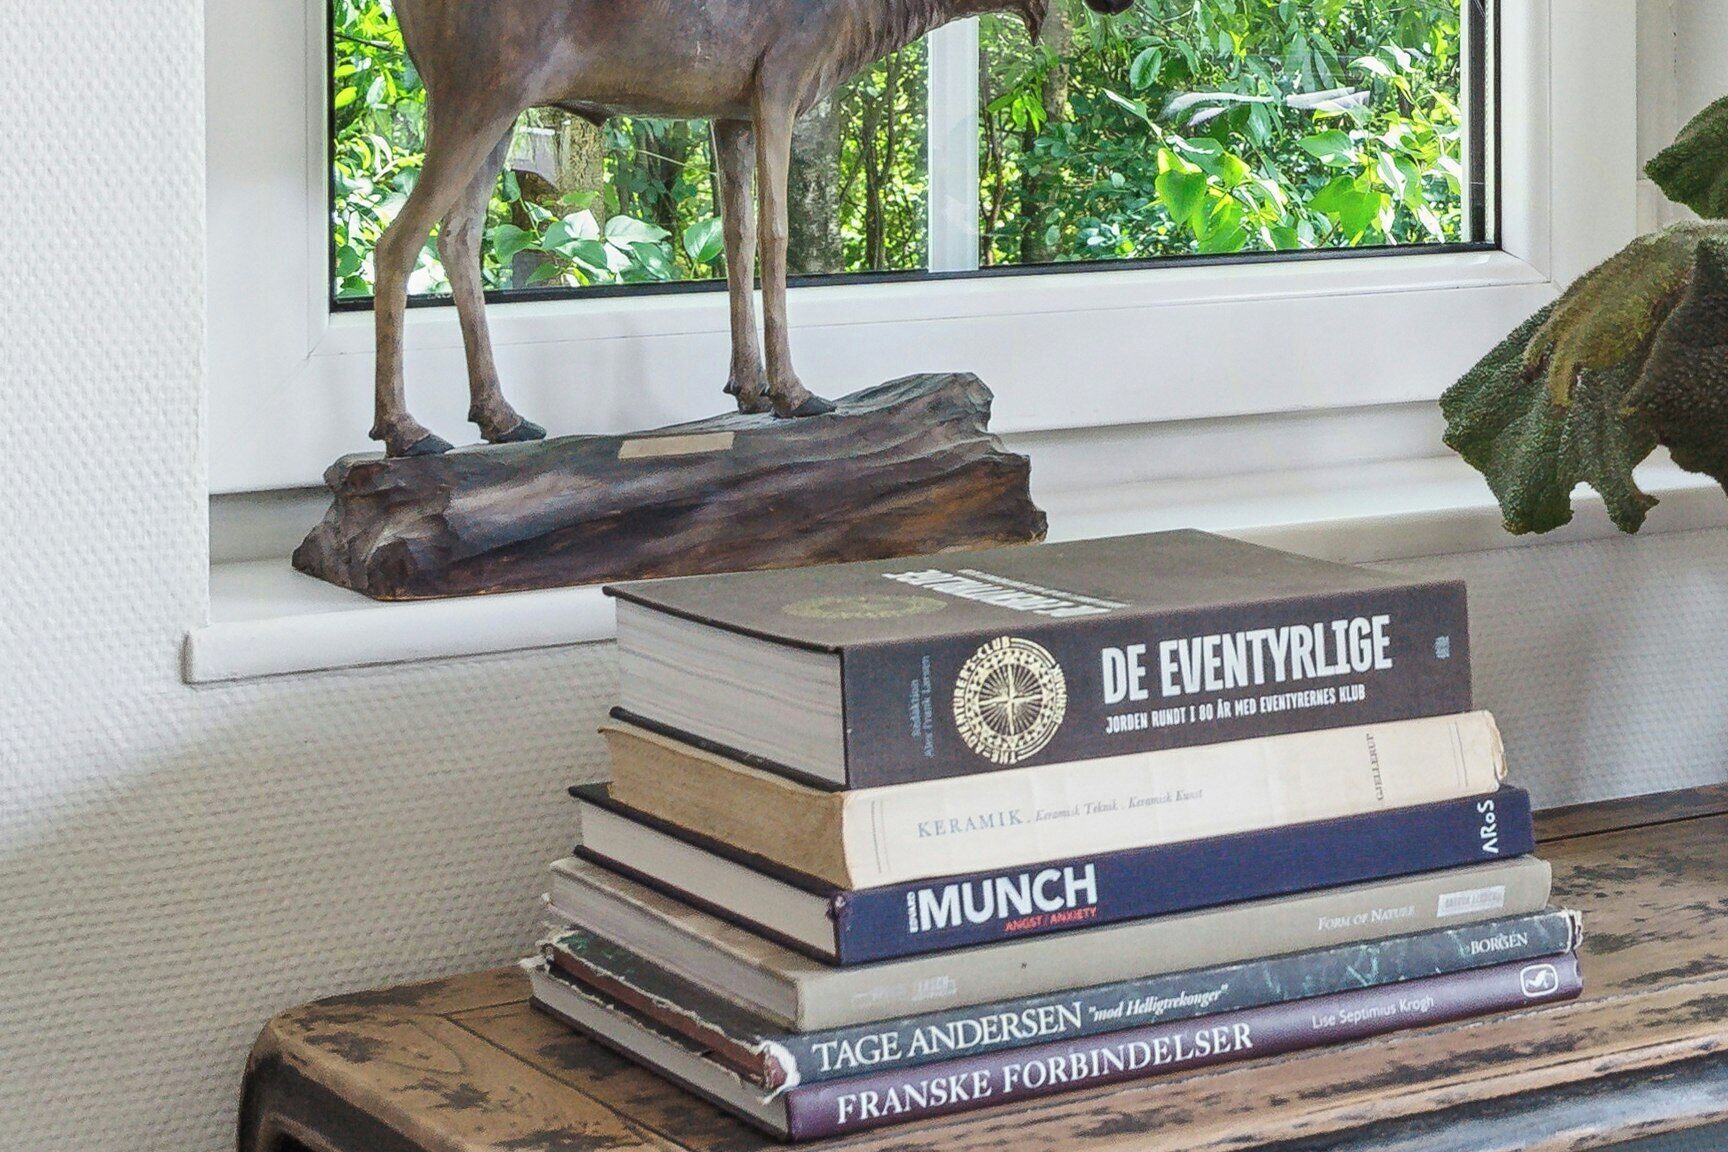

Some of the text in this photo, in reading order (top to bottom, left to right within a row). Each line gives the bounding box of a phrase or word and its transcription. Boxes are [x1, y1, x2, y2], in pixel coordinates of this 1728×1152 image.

[1102, 614, 1393, 705] DE EVENTYRLIGE
[1105, 683, 1366, 735] JORDEN RUNDT I 80 ÅR MED EVENTYRERNES KLUB
[917, 808, 1023, 838] KERAMIK
[917, 863, 1099, 931] MUNCH
[1470, 931, 1529, 955] BORGEN
[812, 1031, 902, 1073] TAGE
[908, 1000, 1084, 1059] ANDERSEN
[1311, 995, 1435, 1029] Lise Septimius Krogh
[836, 1021, 1254, 1125] FRANSKE FORBINDELSER
